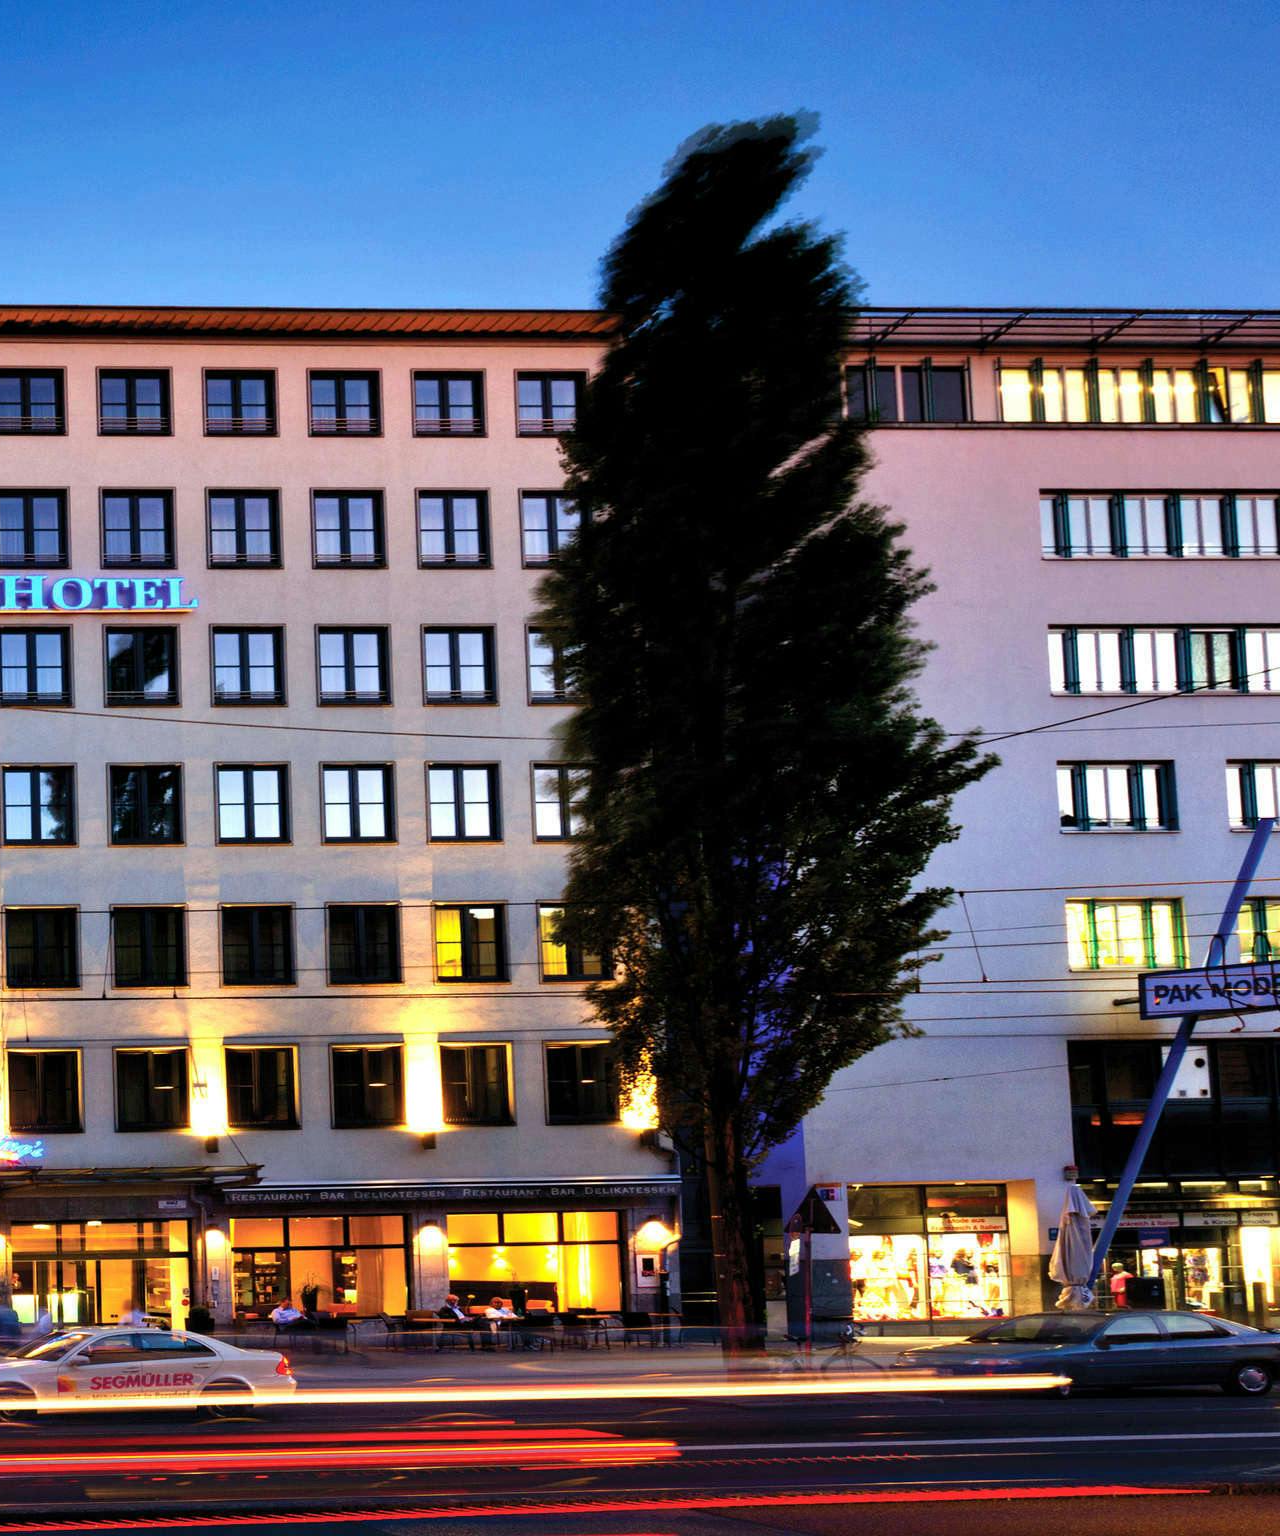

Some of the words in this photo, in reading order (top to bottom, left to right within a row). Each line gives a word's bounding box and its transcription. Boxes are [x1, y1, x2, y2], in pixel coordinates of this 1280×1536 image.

[0, 574, 199, 610] HOTEL
[1153, 983, 1203, 1006] PAK
[319, 1190, 345, 1200] BAR
[550, 1186, 576, 1196] BAR
[90, 1372, 194, 1390] SEGMÜLLER
